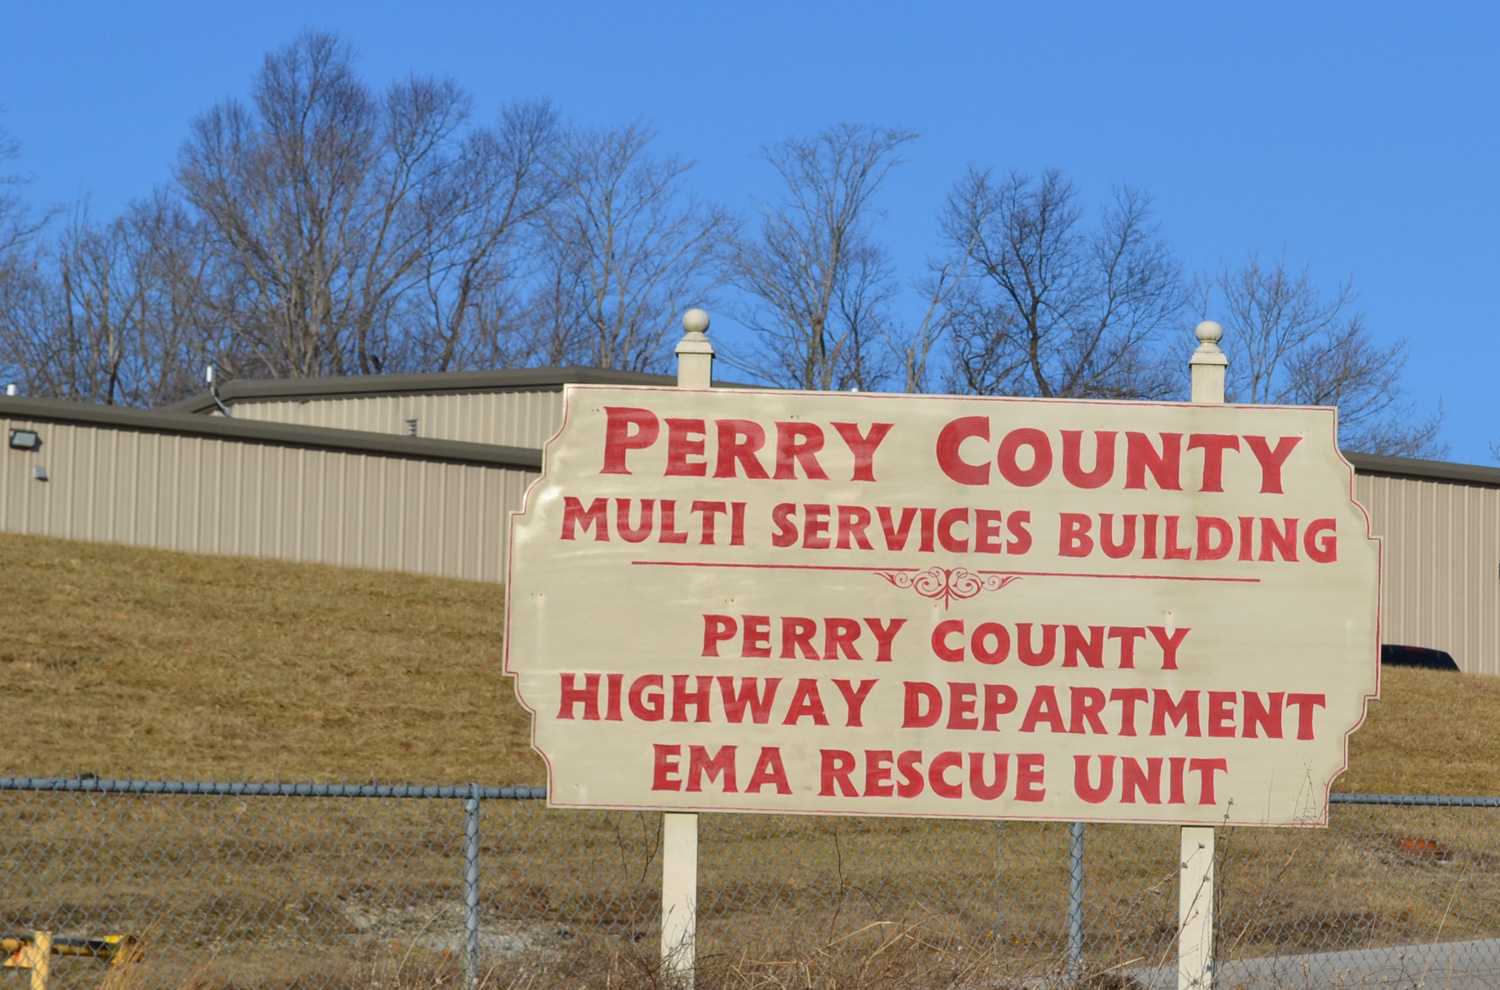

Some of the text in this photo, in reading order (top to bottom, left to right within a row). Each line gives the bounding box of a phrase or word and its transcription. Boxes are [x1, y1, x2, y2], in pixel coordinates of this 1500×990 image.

[599, 406, 1304, 495] PERRY COUNTY
[560, 496, 1338, 564] MULTI SERVICES BUILDING
[701, 613, 1191, 671] PERRY COUNTY
[556, 672, 1327, 741] HIGHWAY DEPARTMENT
[651, 743, 1229, 806] EMA RESCUE UNIT
